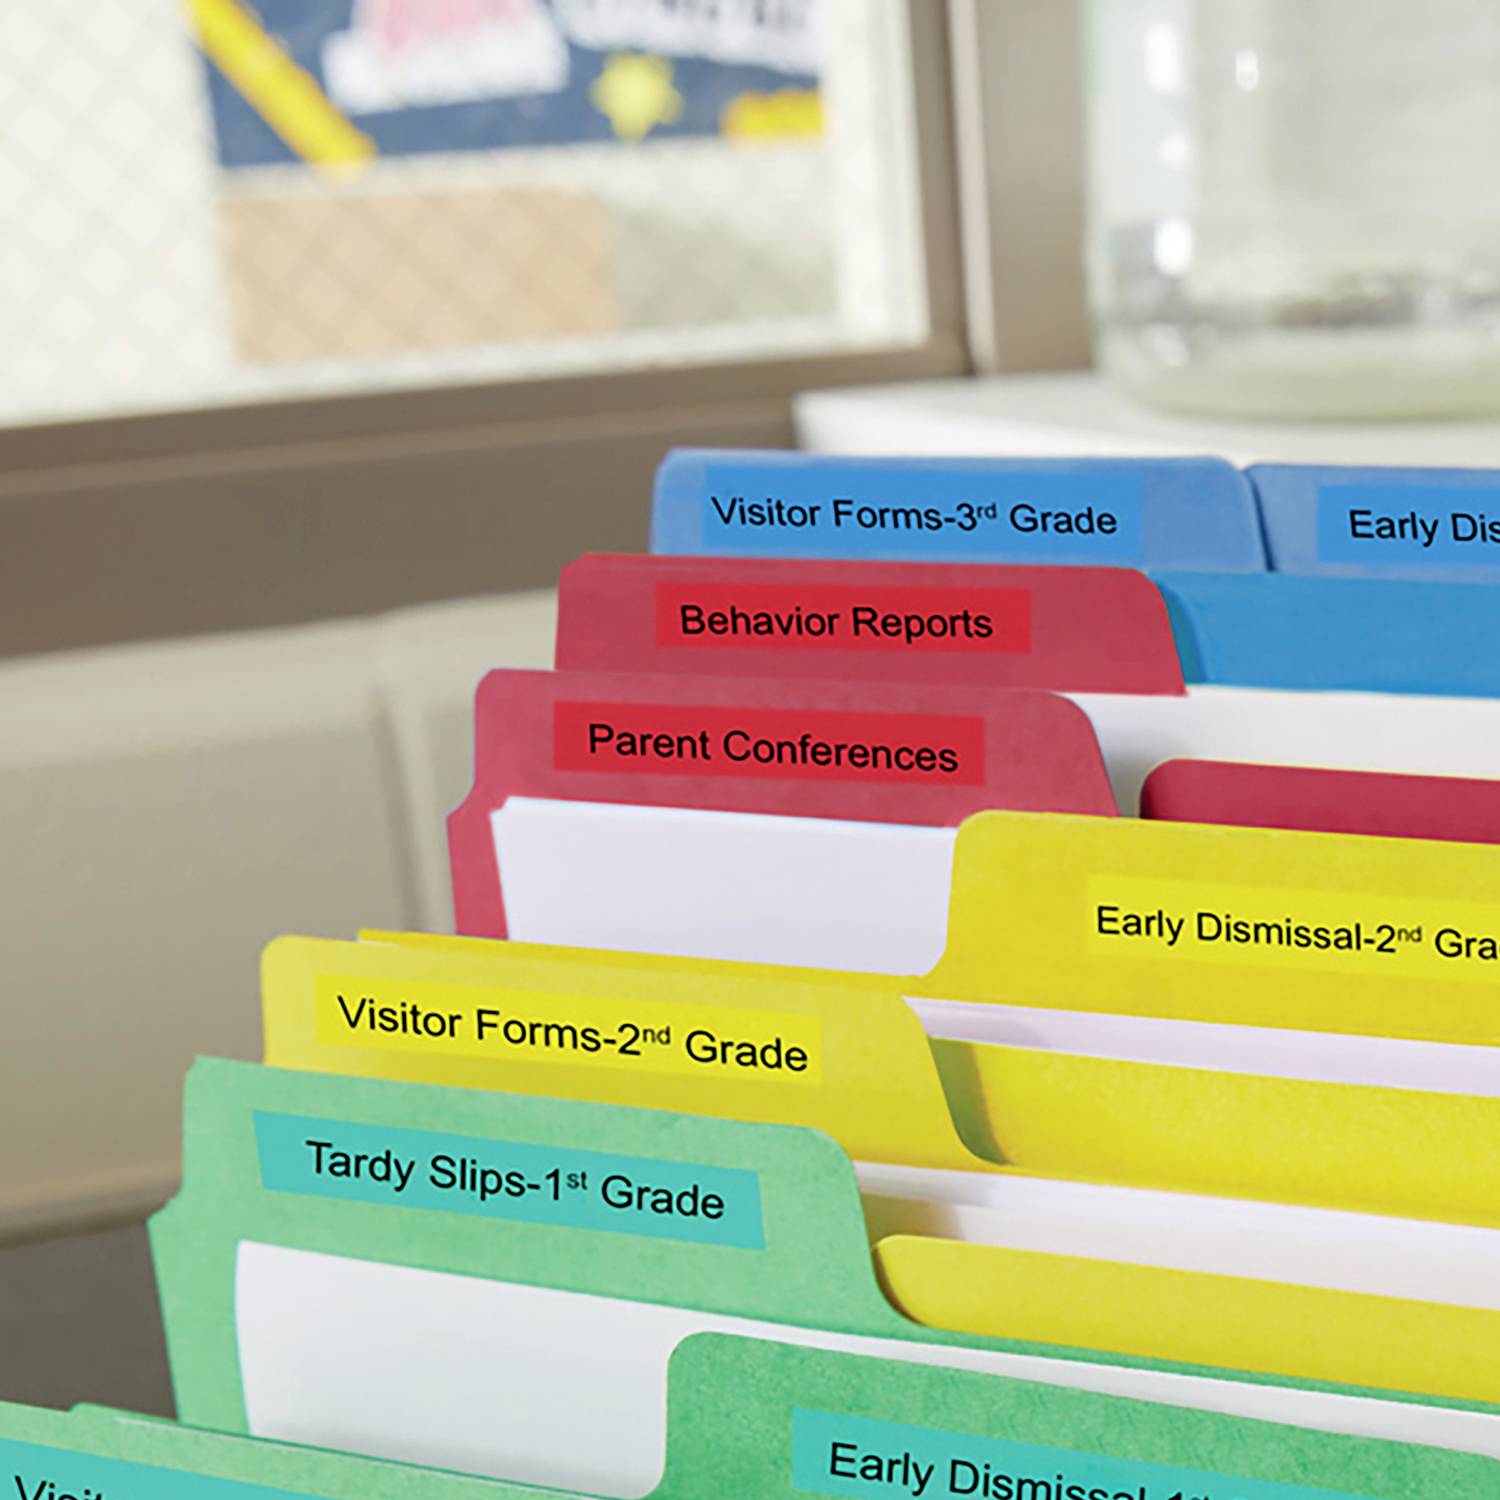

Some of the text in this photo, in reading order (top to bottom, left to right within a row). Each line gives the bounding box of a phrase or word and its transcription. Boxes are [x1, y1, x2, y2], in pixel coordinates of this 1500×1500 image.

[711, 496, 1117, 535] Visitor Forms-3rd Grade
[1349, 509, 1439, 548] Early
[680, 604, 993, 645] Behavior Reports
[589, 723, 959, 773] Parent Conferences
[1097, 905, 1185, 947] Early
[1196, 912, 1422, 954] Dismissal-2nd
[337, 995, 808, 1072] Visitor Forms-2nd Grade
[305, 1140, 725, 1220] Tardy Slips-1st Grade
[829, 1441, 935, 1497] Early
